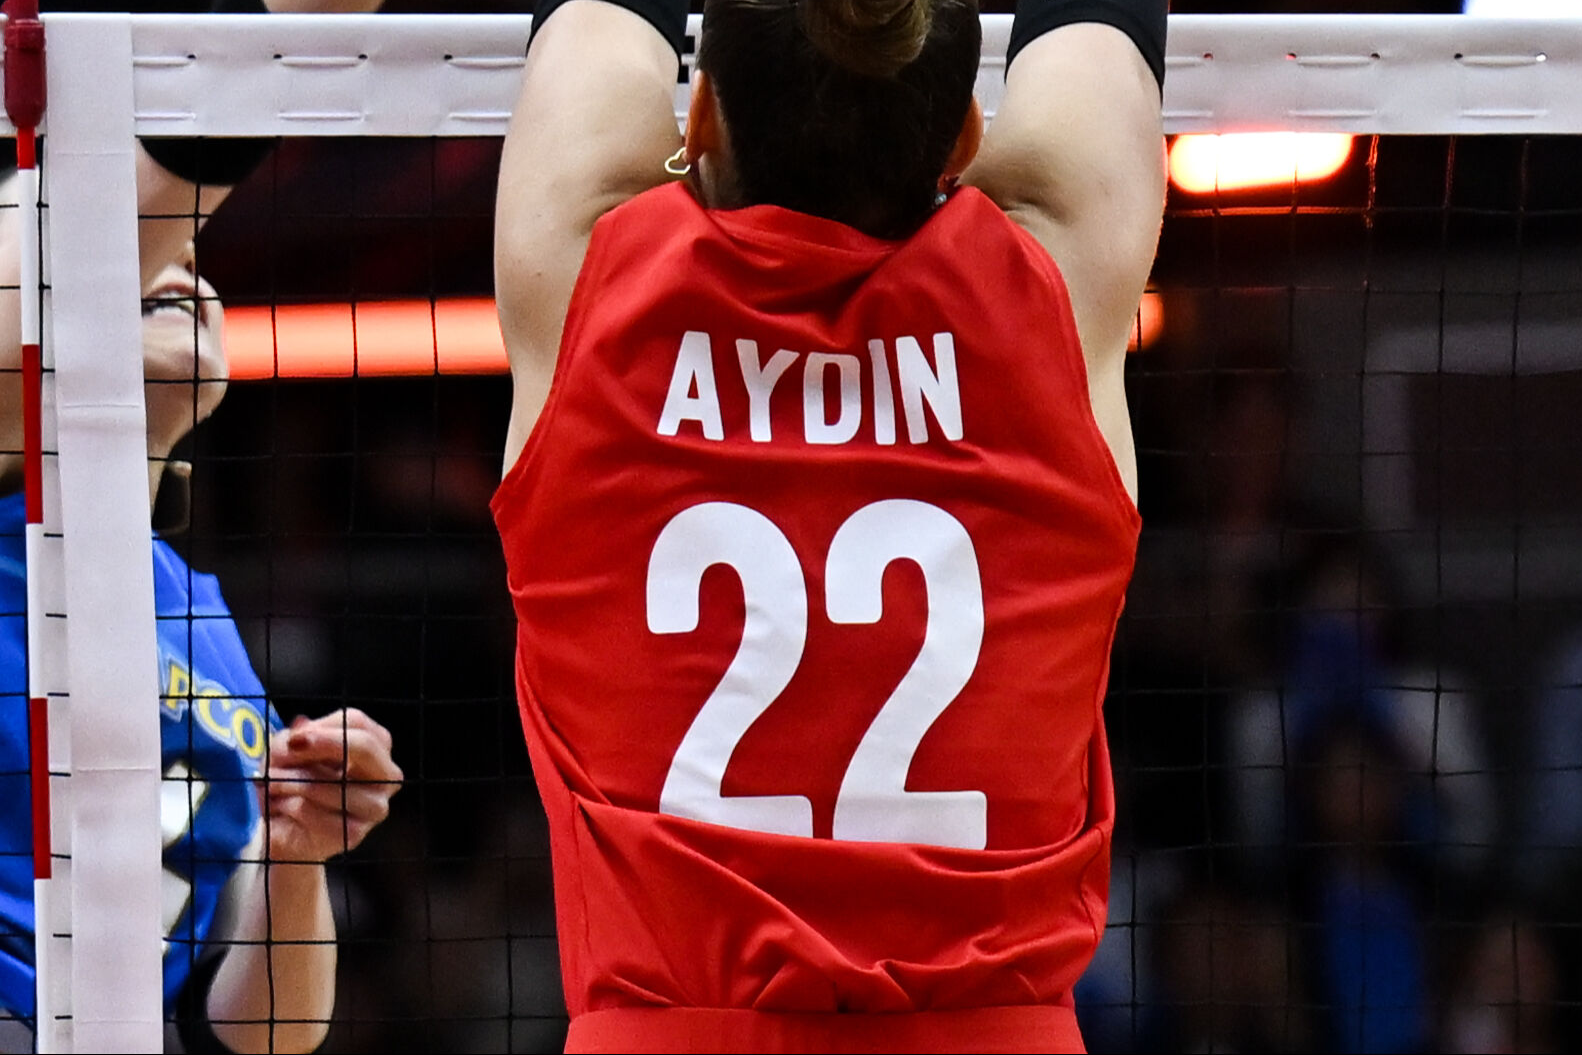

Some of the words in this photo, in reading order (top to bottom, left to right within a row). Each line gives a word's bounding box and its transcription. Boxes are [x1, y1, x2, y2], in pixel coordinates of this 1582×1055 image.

[656, 331, 964, 445] AYDIN
[162, 662, 266, 759] PCO
[646, 499, 988, 850] 22
